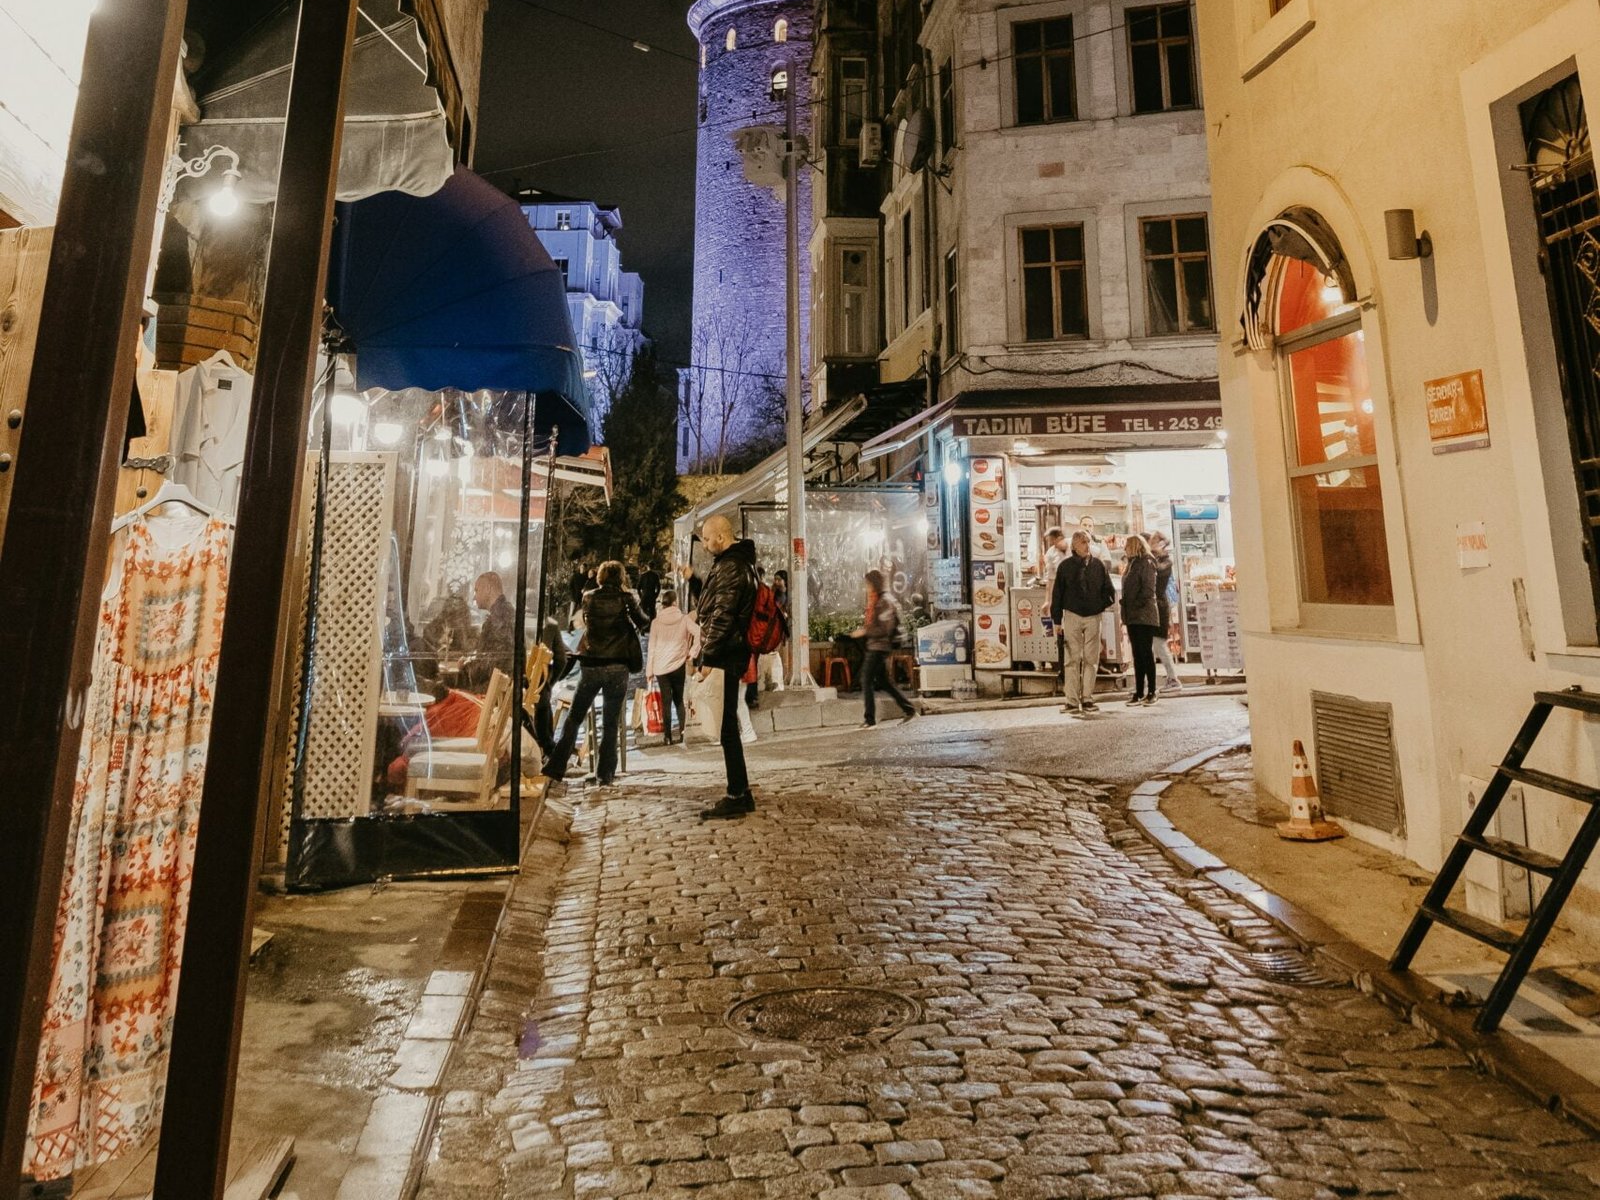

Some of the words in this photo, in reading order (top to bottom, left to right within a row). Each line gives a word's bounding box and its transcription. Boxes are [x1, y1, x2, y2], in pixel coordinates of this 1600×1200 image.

[963, 417, 1032, 435] TADIM
[1046, 413, 1107, 433] BÜFE
[1122, 418, 1154, 432] TEL
[1168, 416, 1200, 430] 243
